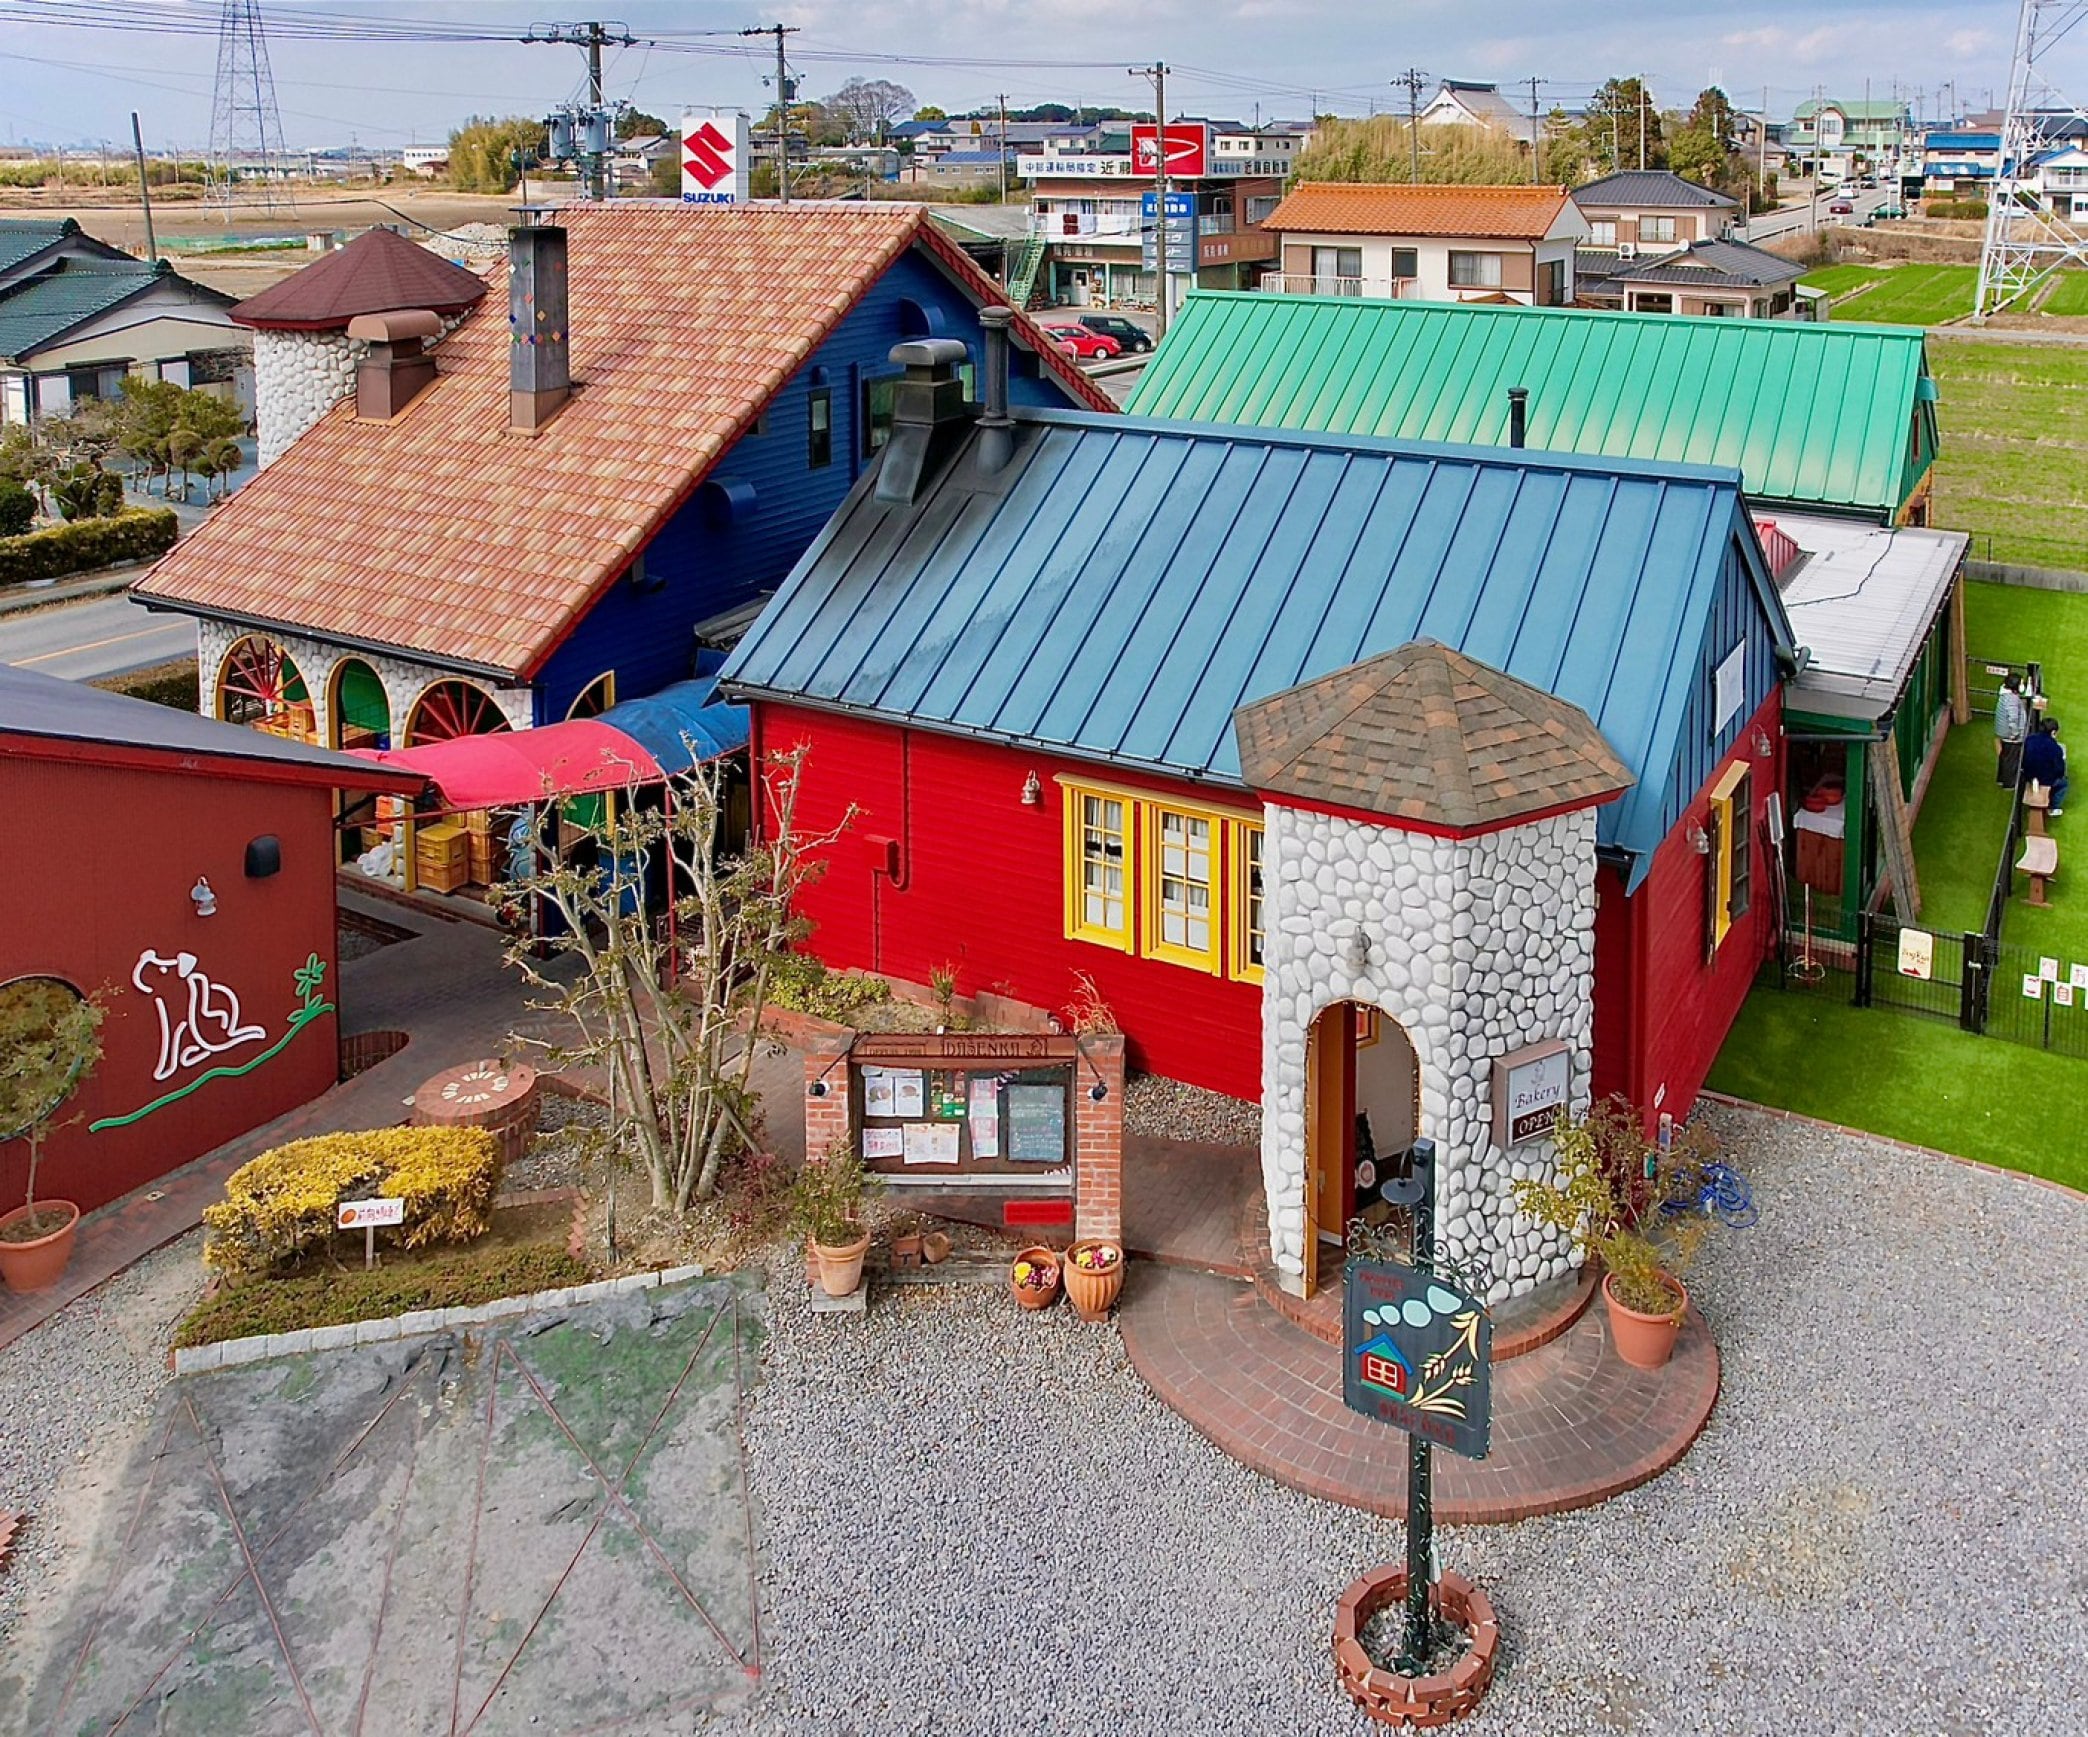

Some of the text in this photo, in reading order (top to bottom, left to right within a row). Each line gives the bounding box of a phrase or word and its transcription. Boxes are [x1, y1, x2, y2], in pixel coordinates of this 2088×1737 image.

[683, 192, 734, 203] SUZUKI
[1515, 1083, 1561, 1109] Bakery
[1519, 1107, 1557, 1134] OPEN
